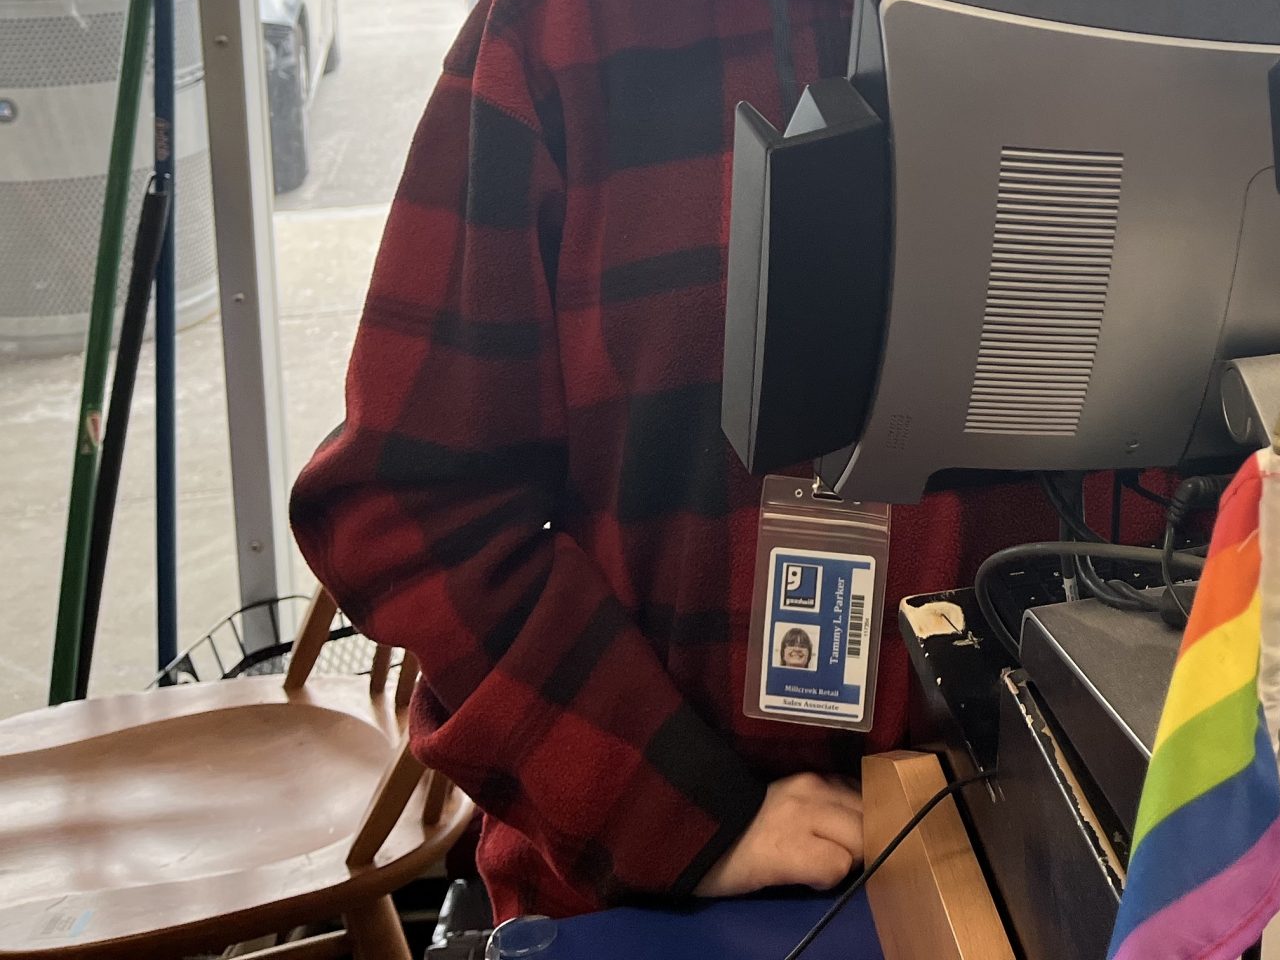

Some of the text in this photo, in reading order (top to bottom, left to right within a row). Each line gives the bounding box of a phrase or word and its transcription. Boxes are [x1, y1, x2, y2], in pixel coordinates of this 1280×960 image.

[830, 576, 845, 664] Tammy L. Parker
[785, 684, 839, 697] Millcreek Retail
[783, 698, 839, 711] Sales Associate
